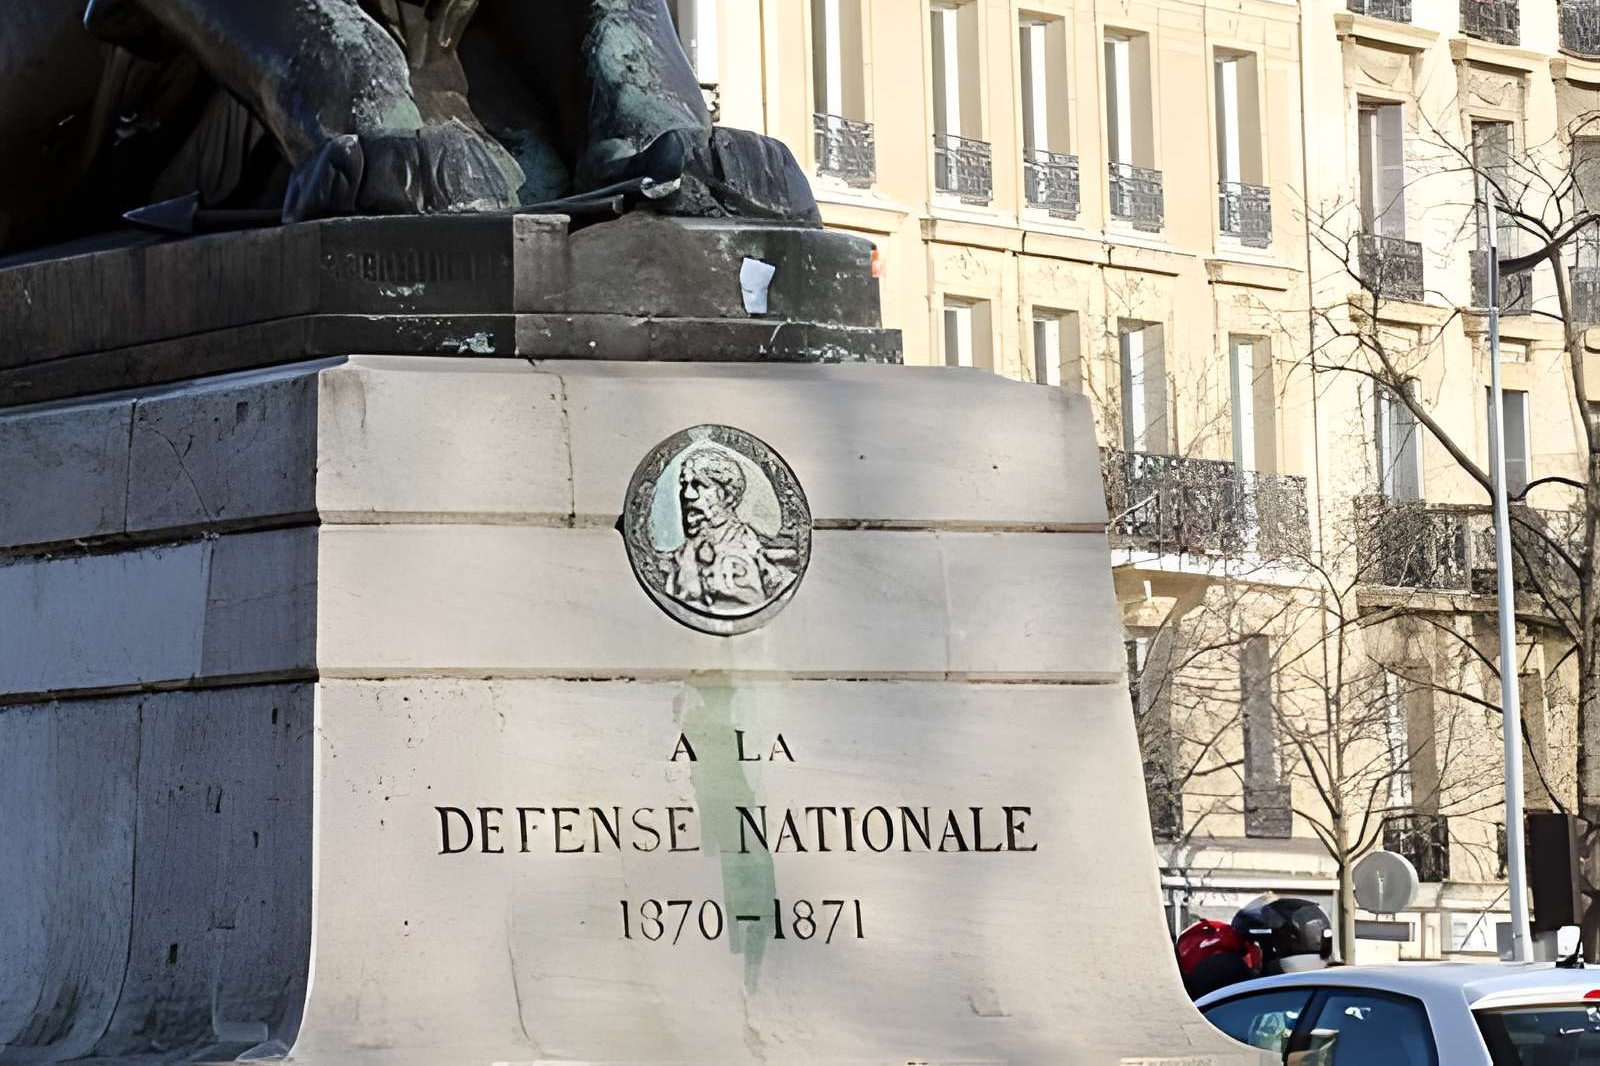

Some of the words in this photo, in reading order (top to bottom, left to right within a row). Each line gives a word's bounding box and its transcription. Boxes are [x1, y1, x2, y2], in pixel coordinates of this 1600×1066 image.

[670, 732, 698, 762] A
[734, 729, 796, 762] LA
[434, 806, 700, 855] DEFENSE
[735, 805, 1038, 854] NATIONALE
